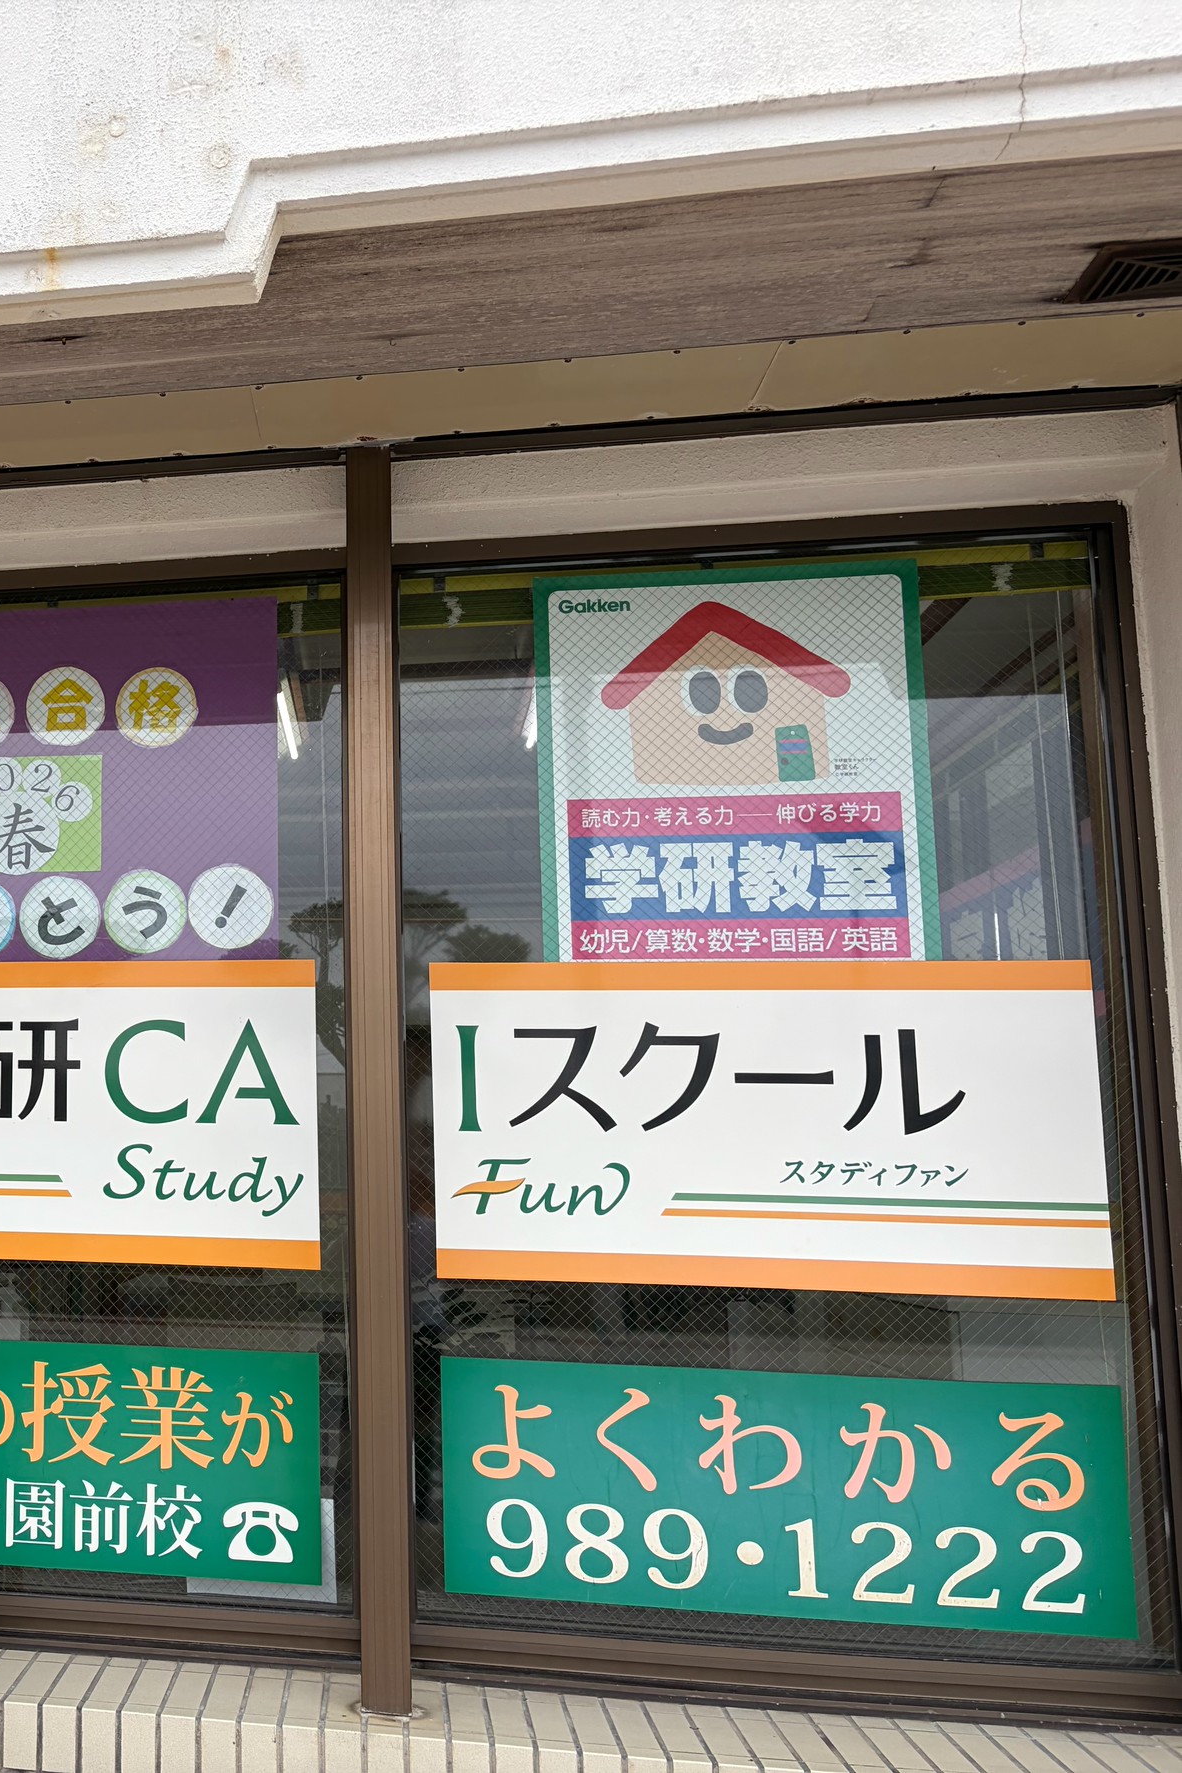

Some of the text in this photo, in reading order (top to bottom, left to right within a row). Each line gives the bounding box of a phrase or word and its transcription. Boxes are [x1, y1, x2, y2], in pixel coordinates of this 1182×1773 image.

[558, 599, 631, 614] Gakken
[584, 839, 897, 915] 学研教室
[102, 1143, 305, 1217] Study
[450, 1157, 631, 1216] Fun
[778, 1158, 969, 1188] スタディファン
[472, 1384, 1086, 1512] よくわかる
